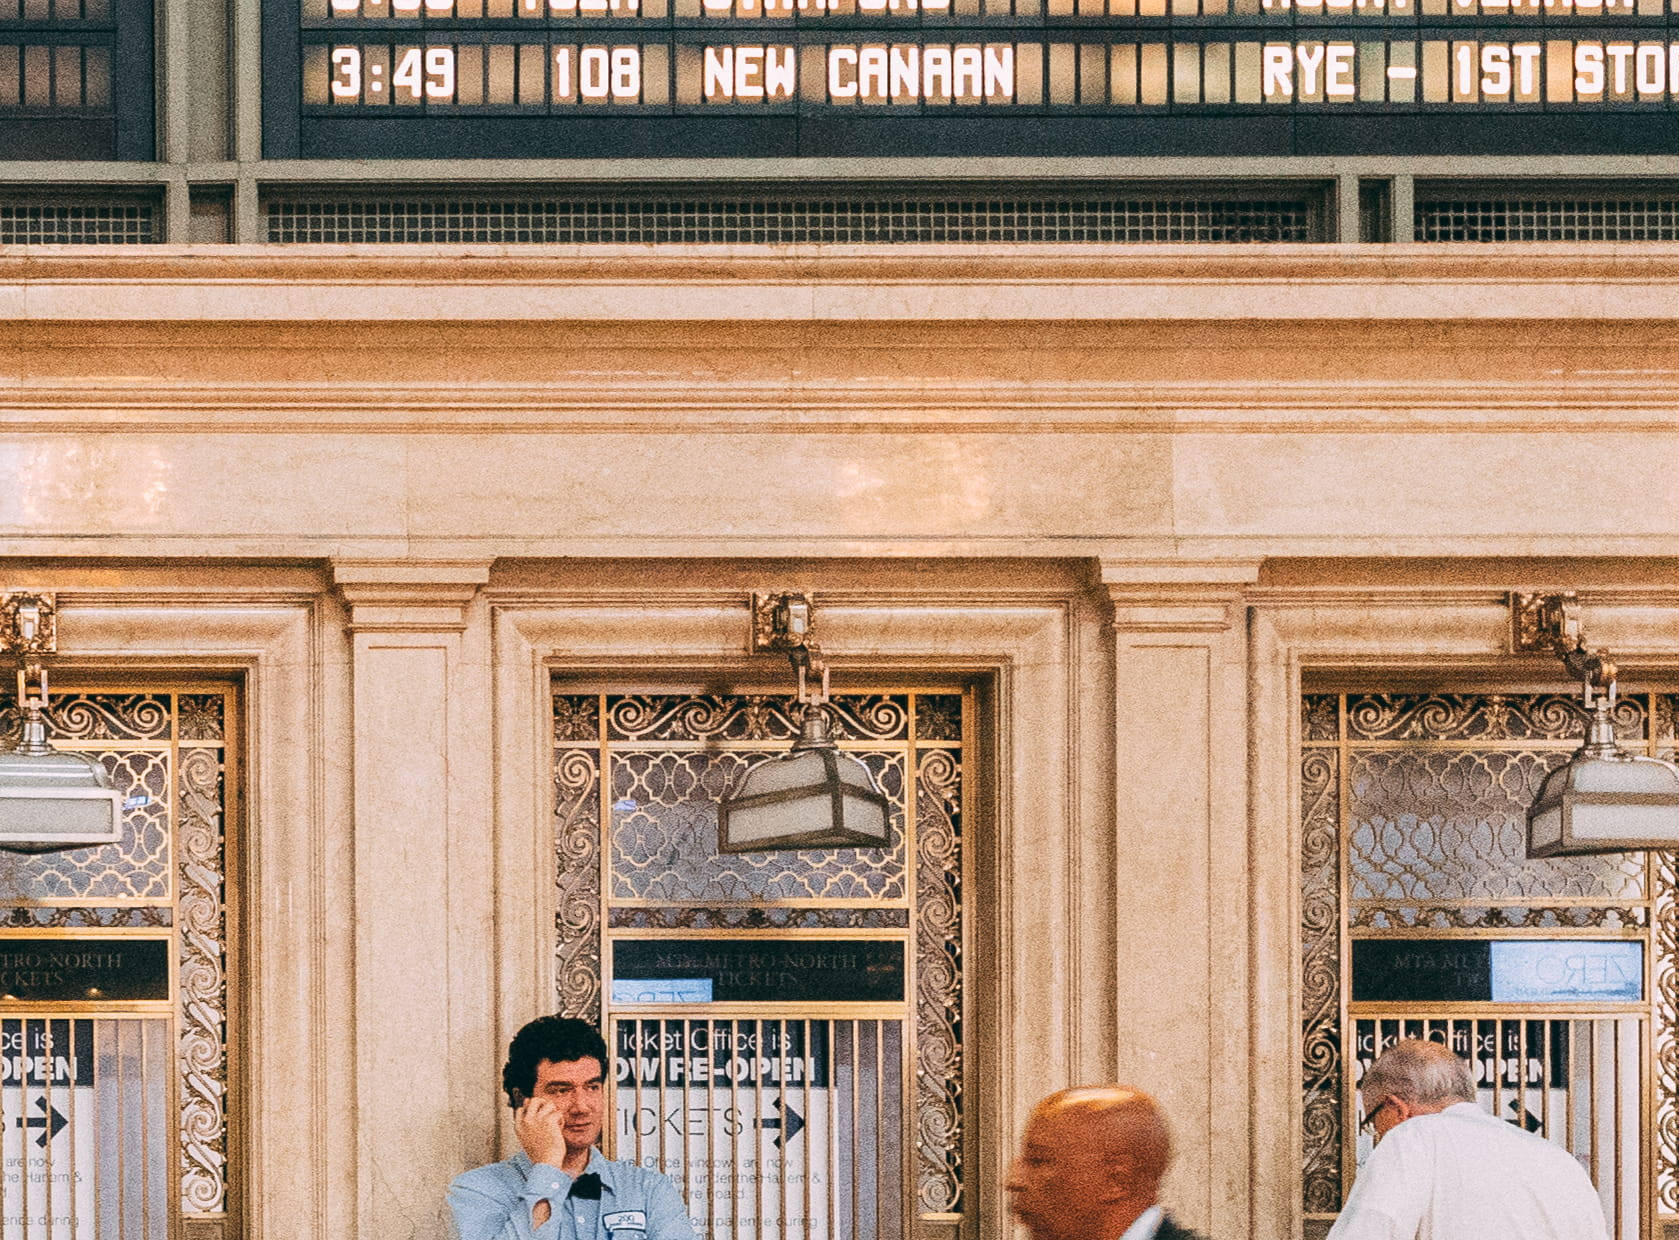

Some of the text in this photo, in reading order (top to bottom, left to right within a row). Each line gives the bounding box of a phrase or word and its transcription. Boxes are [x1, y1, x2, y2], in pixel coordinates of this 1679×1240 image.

[332, 48, 454, 97] 3:49
[555, 48, 640, 97] 108
[704, 47, 795, 97] NEW
[829, 47, 1013, 98] CANAAN
[1263, 45, 1354, 95] RYE
[1457, 45, 1540, 95] 1ST
[34, 1027, 55, 1050] is
[772, 1027, 792, 1051] is
[669, 1056, 815, 1082] RE-OPEN
